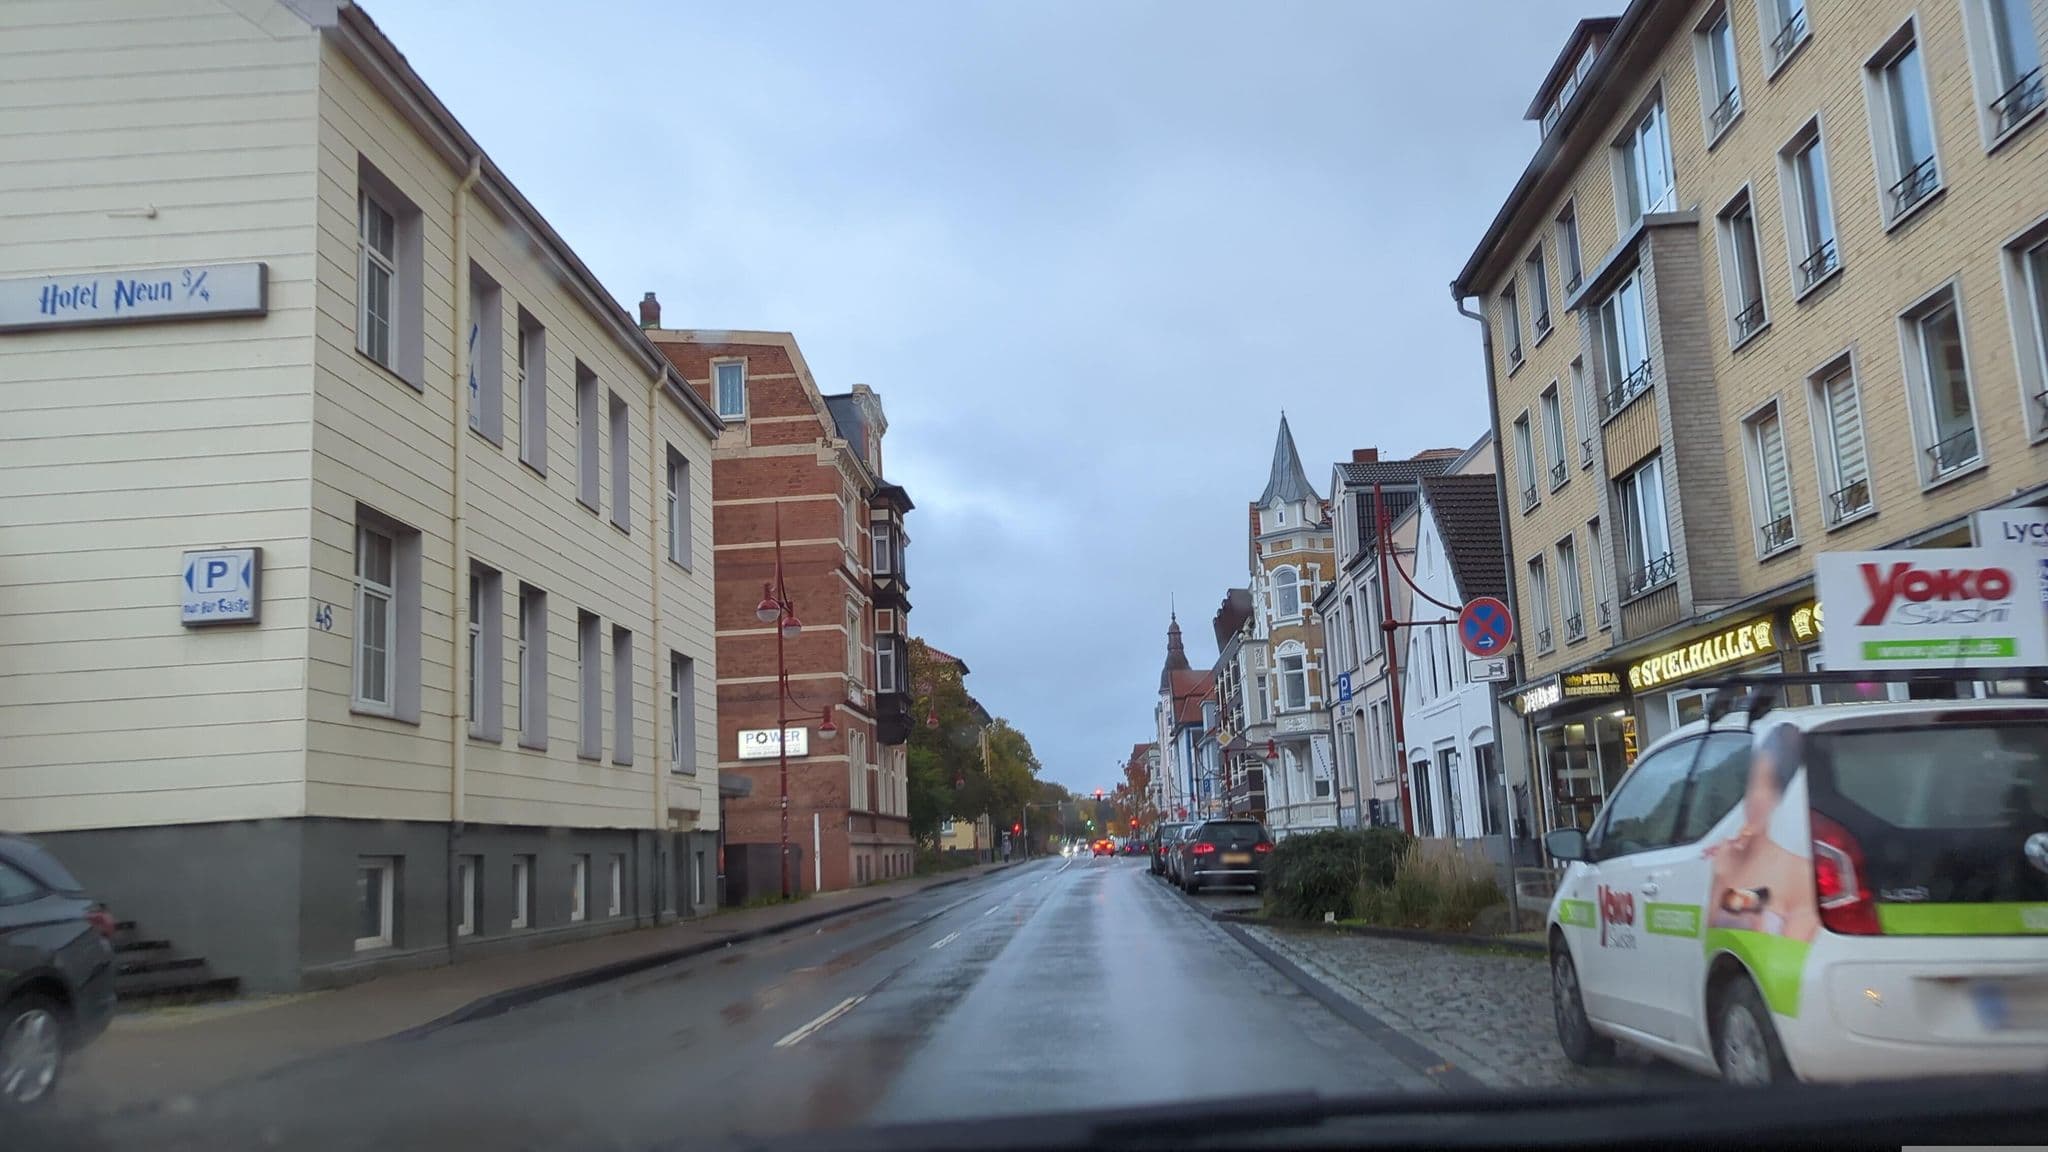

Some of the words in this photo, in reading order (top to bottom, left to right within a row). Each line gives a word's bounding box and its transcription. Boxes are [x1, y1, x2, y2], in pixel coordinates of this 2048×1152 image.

[39, 280, 98, 316] Hotel
[114, 279, 172, 312] Neun
[2003, 521, 2048, 543] Lyc
[206, 561, 229, 588] P
[1893, 601, 2014, 626] Sushi
[1641, 624, 1756, 686] SPIELHALLE
[1582, 672, 1620, 685] PETRA
[745, 730, 801, 745] POWER
